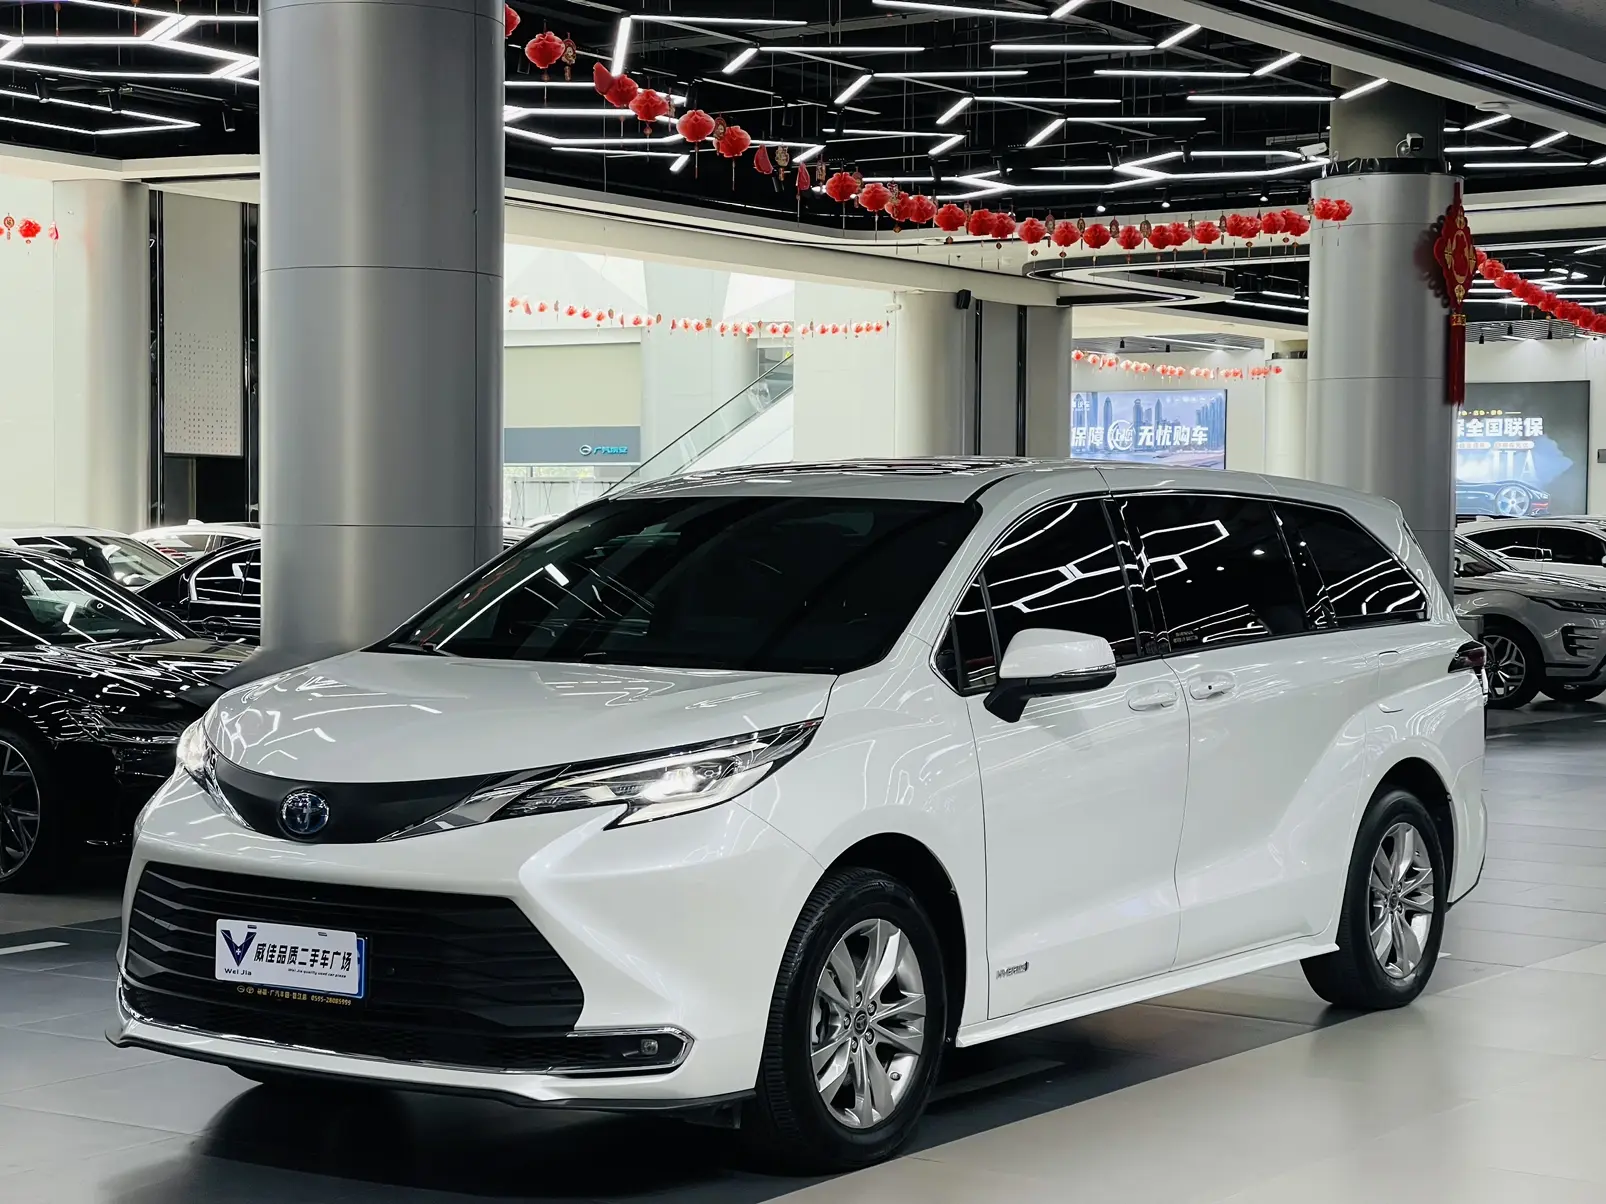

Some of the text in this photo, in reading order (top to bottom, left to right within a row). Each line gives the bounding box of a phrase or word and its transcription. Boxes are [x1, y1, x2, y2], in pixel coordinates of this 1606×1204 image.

[1071, 426, 1104, 446] 保障
[1137, 425, 1209, 446] 无忧购车
[253, 942, 353, 972] 威佳品质二手车广场
